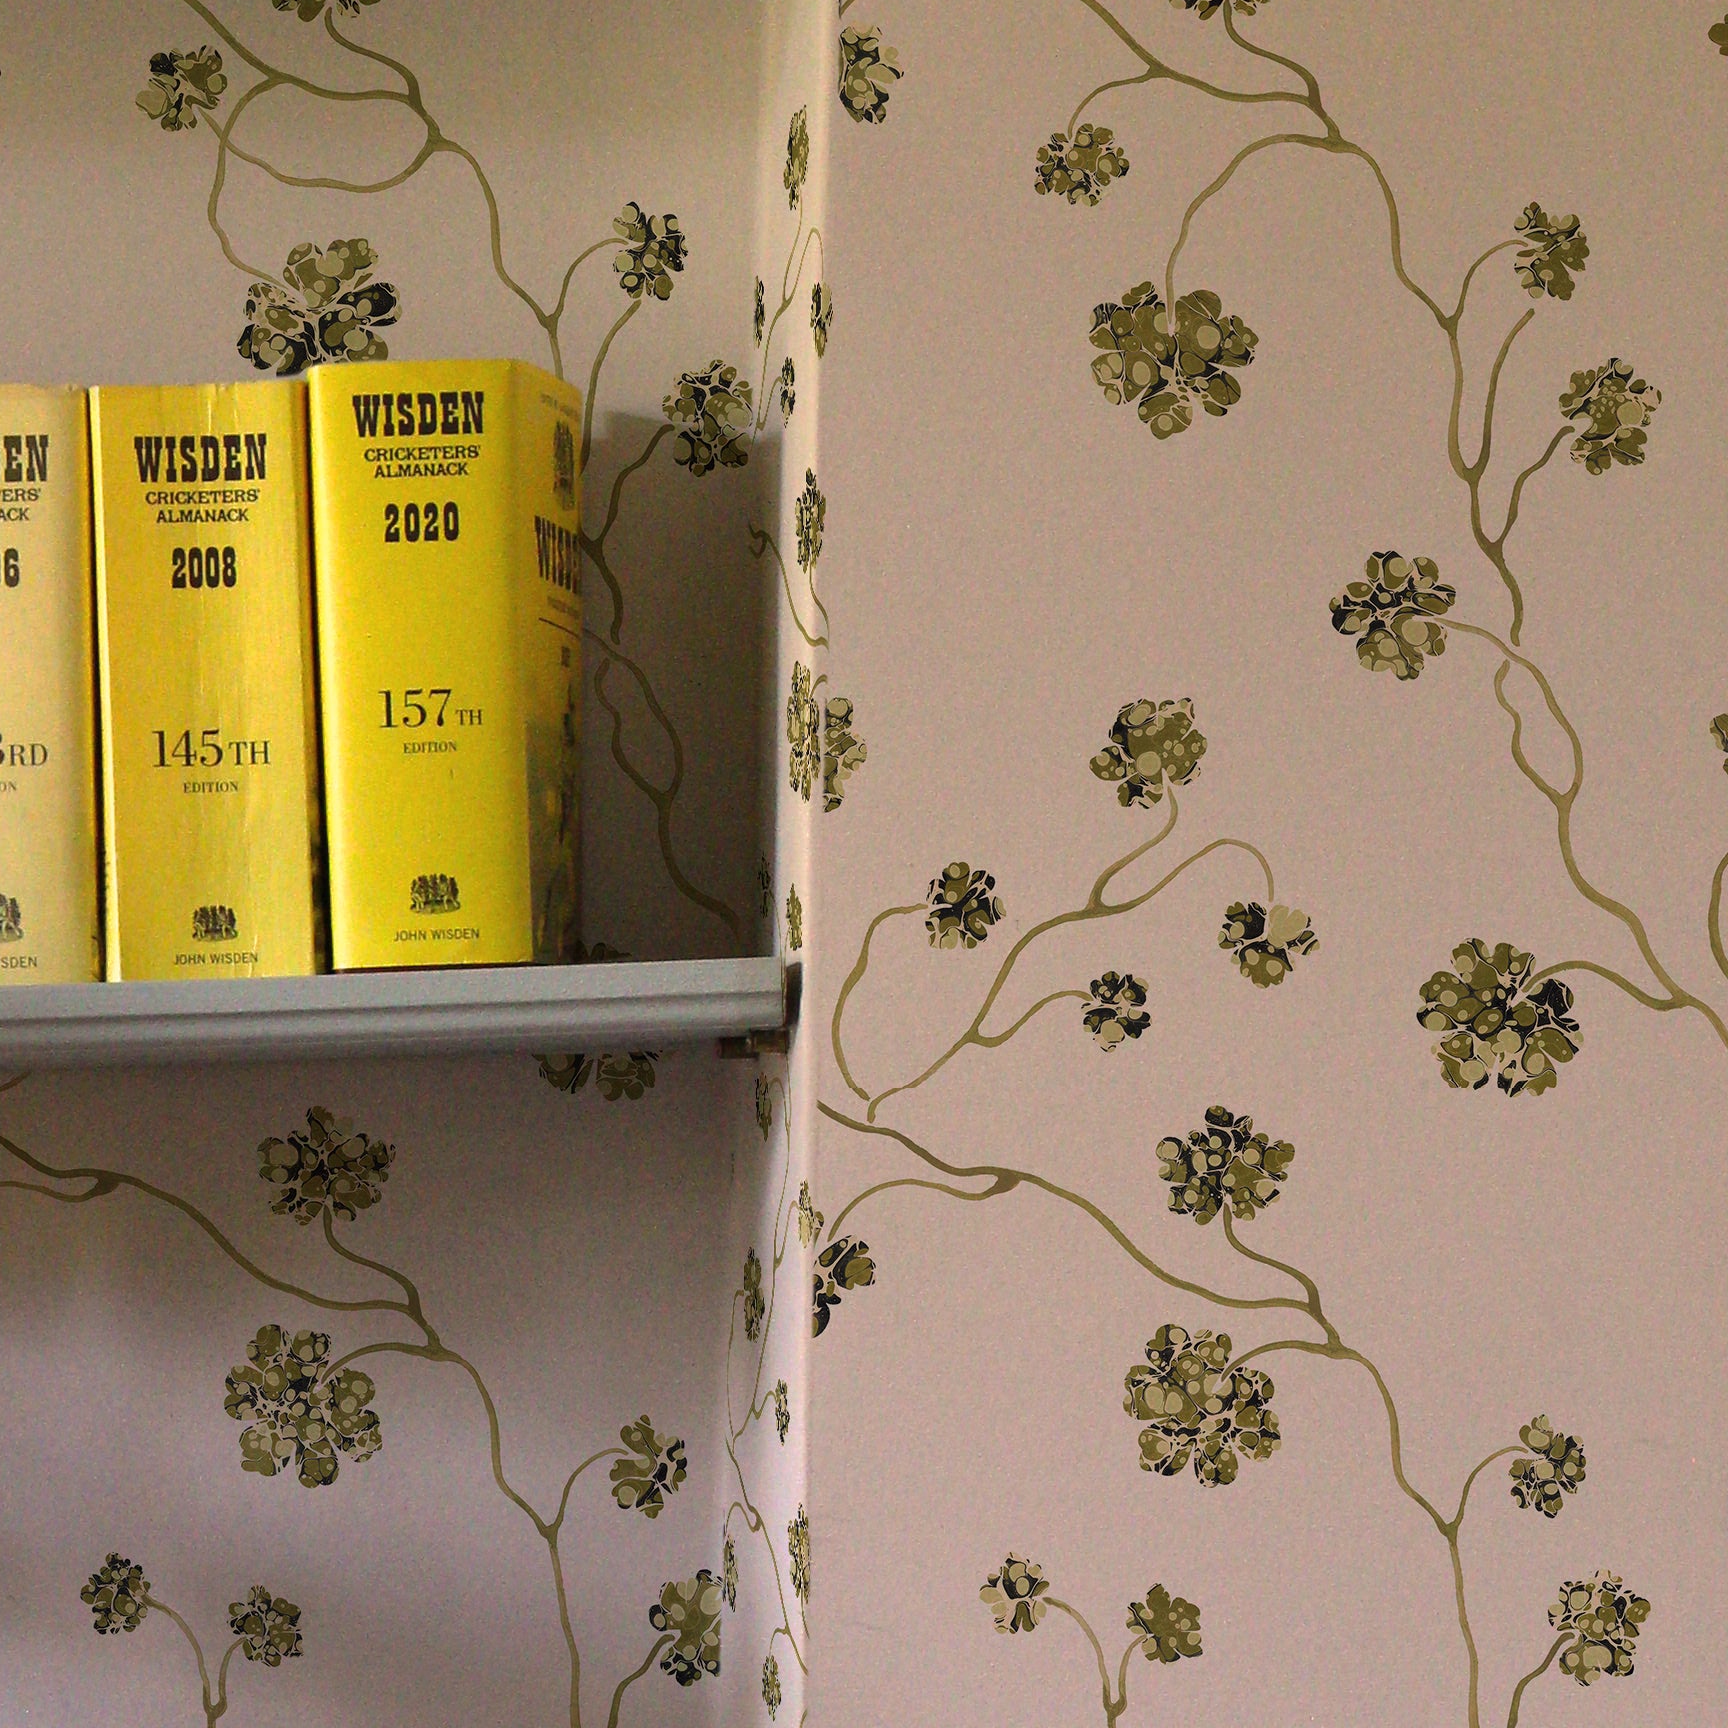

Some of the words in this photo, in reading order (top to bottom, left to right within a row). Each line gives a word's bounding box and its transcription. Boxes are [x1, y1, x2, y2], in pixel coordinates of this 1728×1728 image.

[352, 392, 484, 437] WISDEN
[134, 433, 266, 482] WISDEN
[374, 462, 468, 478] ALMANACK
[157, 508, 249, 523] ALMANACK
[385, 502, 459, 542] 2020
[172, 546, 236, 588] 2008
[378, 689, 482, 728] 157TH
[152, 729, 270, 767] 145TH
[403, 741, 456, 754] EDITION
[184, 781, 238, 793] EDITION
[394, 930, 427, 942] JOHN
[430, 928, 479, 940] WISDEN
[174, 954, 205, 965] JOHN
[210, 950, 258, 965] WISDEN
